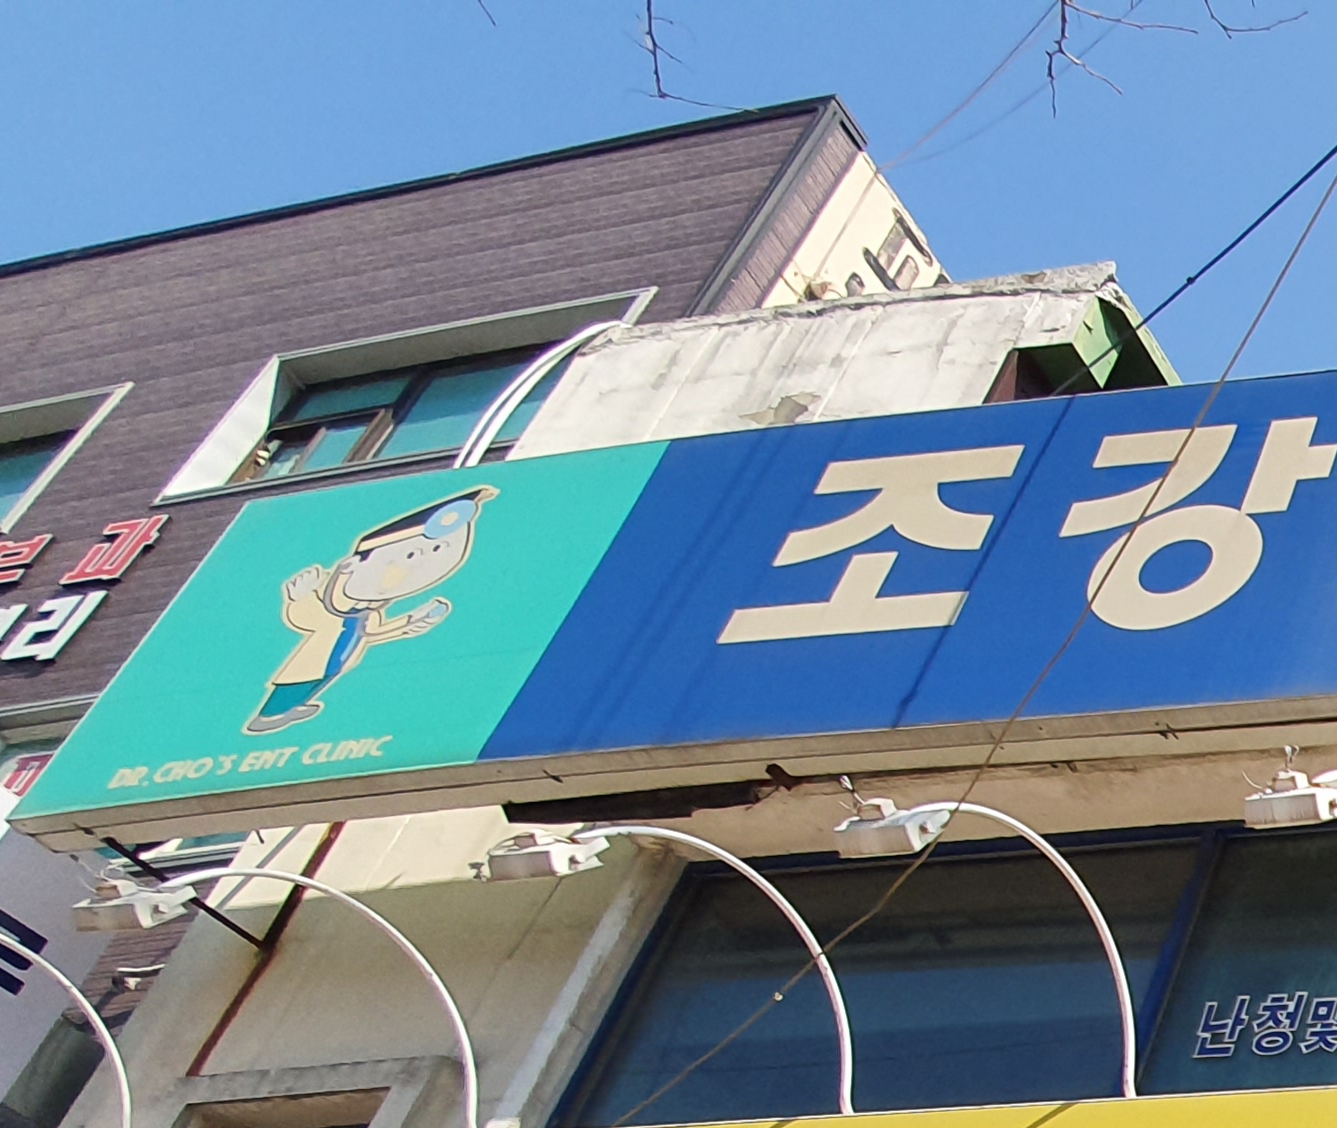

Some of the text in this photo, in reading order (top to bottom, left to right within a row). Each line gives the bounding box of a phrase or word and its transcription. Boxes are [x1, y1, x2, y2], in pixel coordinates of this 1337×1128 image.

[0, 590, 108, 661] 리
[237, 746, 300, 773] ENT
[301, 735, 394, 765] CLINIC
